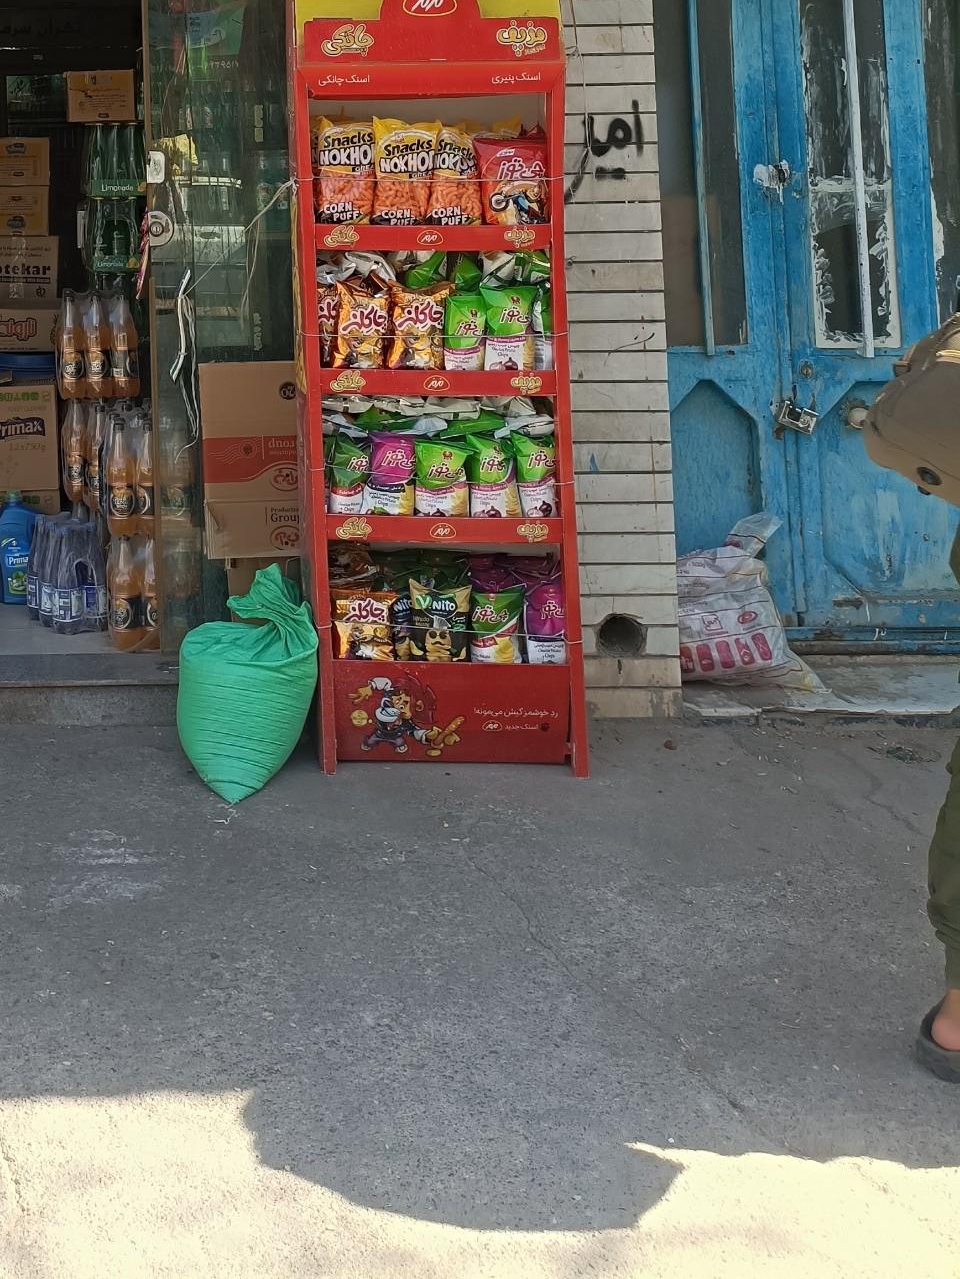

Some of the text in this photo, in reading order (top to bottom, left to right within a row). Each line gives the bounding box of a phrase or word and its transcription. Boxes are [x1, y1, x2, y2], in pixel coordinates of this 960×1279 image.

[323, 132, 373, 148] Snacks
[383, 139, 433, 156] Snacks
[320, 143, 375, 166] NOKHO
[324, 202, 353, 214] CORN
[381, 209, 411, 219] CORN
[432, 206, 461, 218] CORN
[333, 211, 360, 222] PUFF
[441, 216, 468, 226] PUFF
[8, 556, 29, 565] Prima
